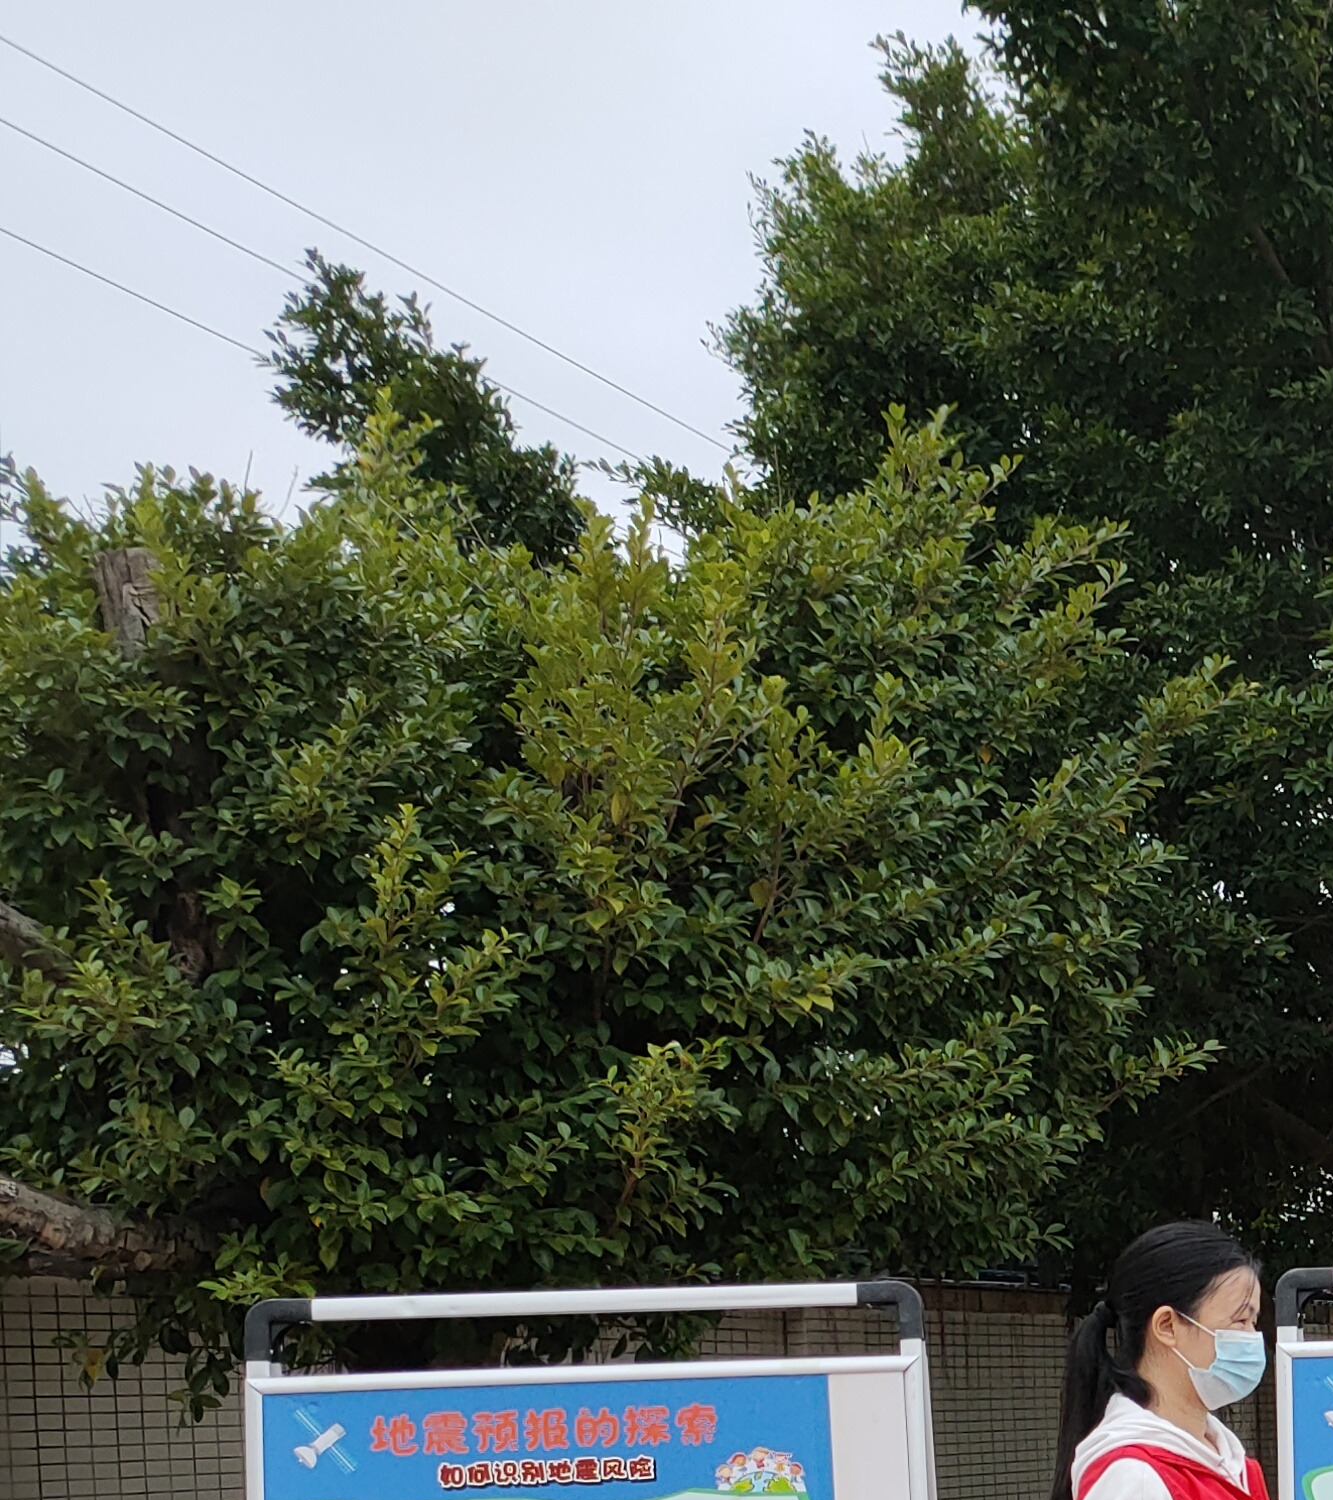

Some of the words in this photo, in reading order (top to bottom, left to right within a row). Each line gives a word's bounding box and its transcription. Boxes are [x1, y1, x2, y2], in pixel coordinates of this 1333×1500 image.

[369, 1403, 718, 1457] 地震预报的探索
[438, 1455, 656, 1488] 如何识别地震风险
